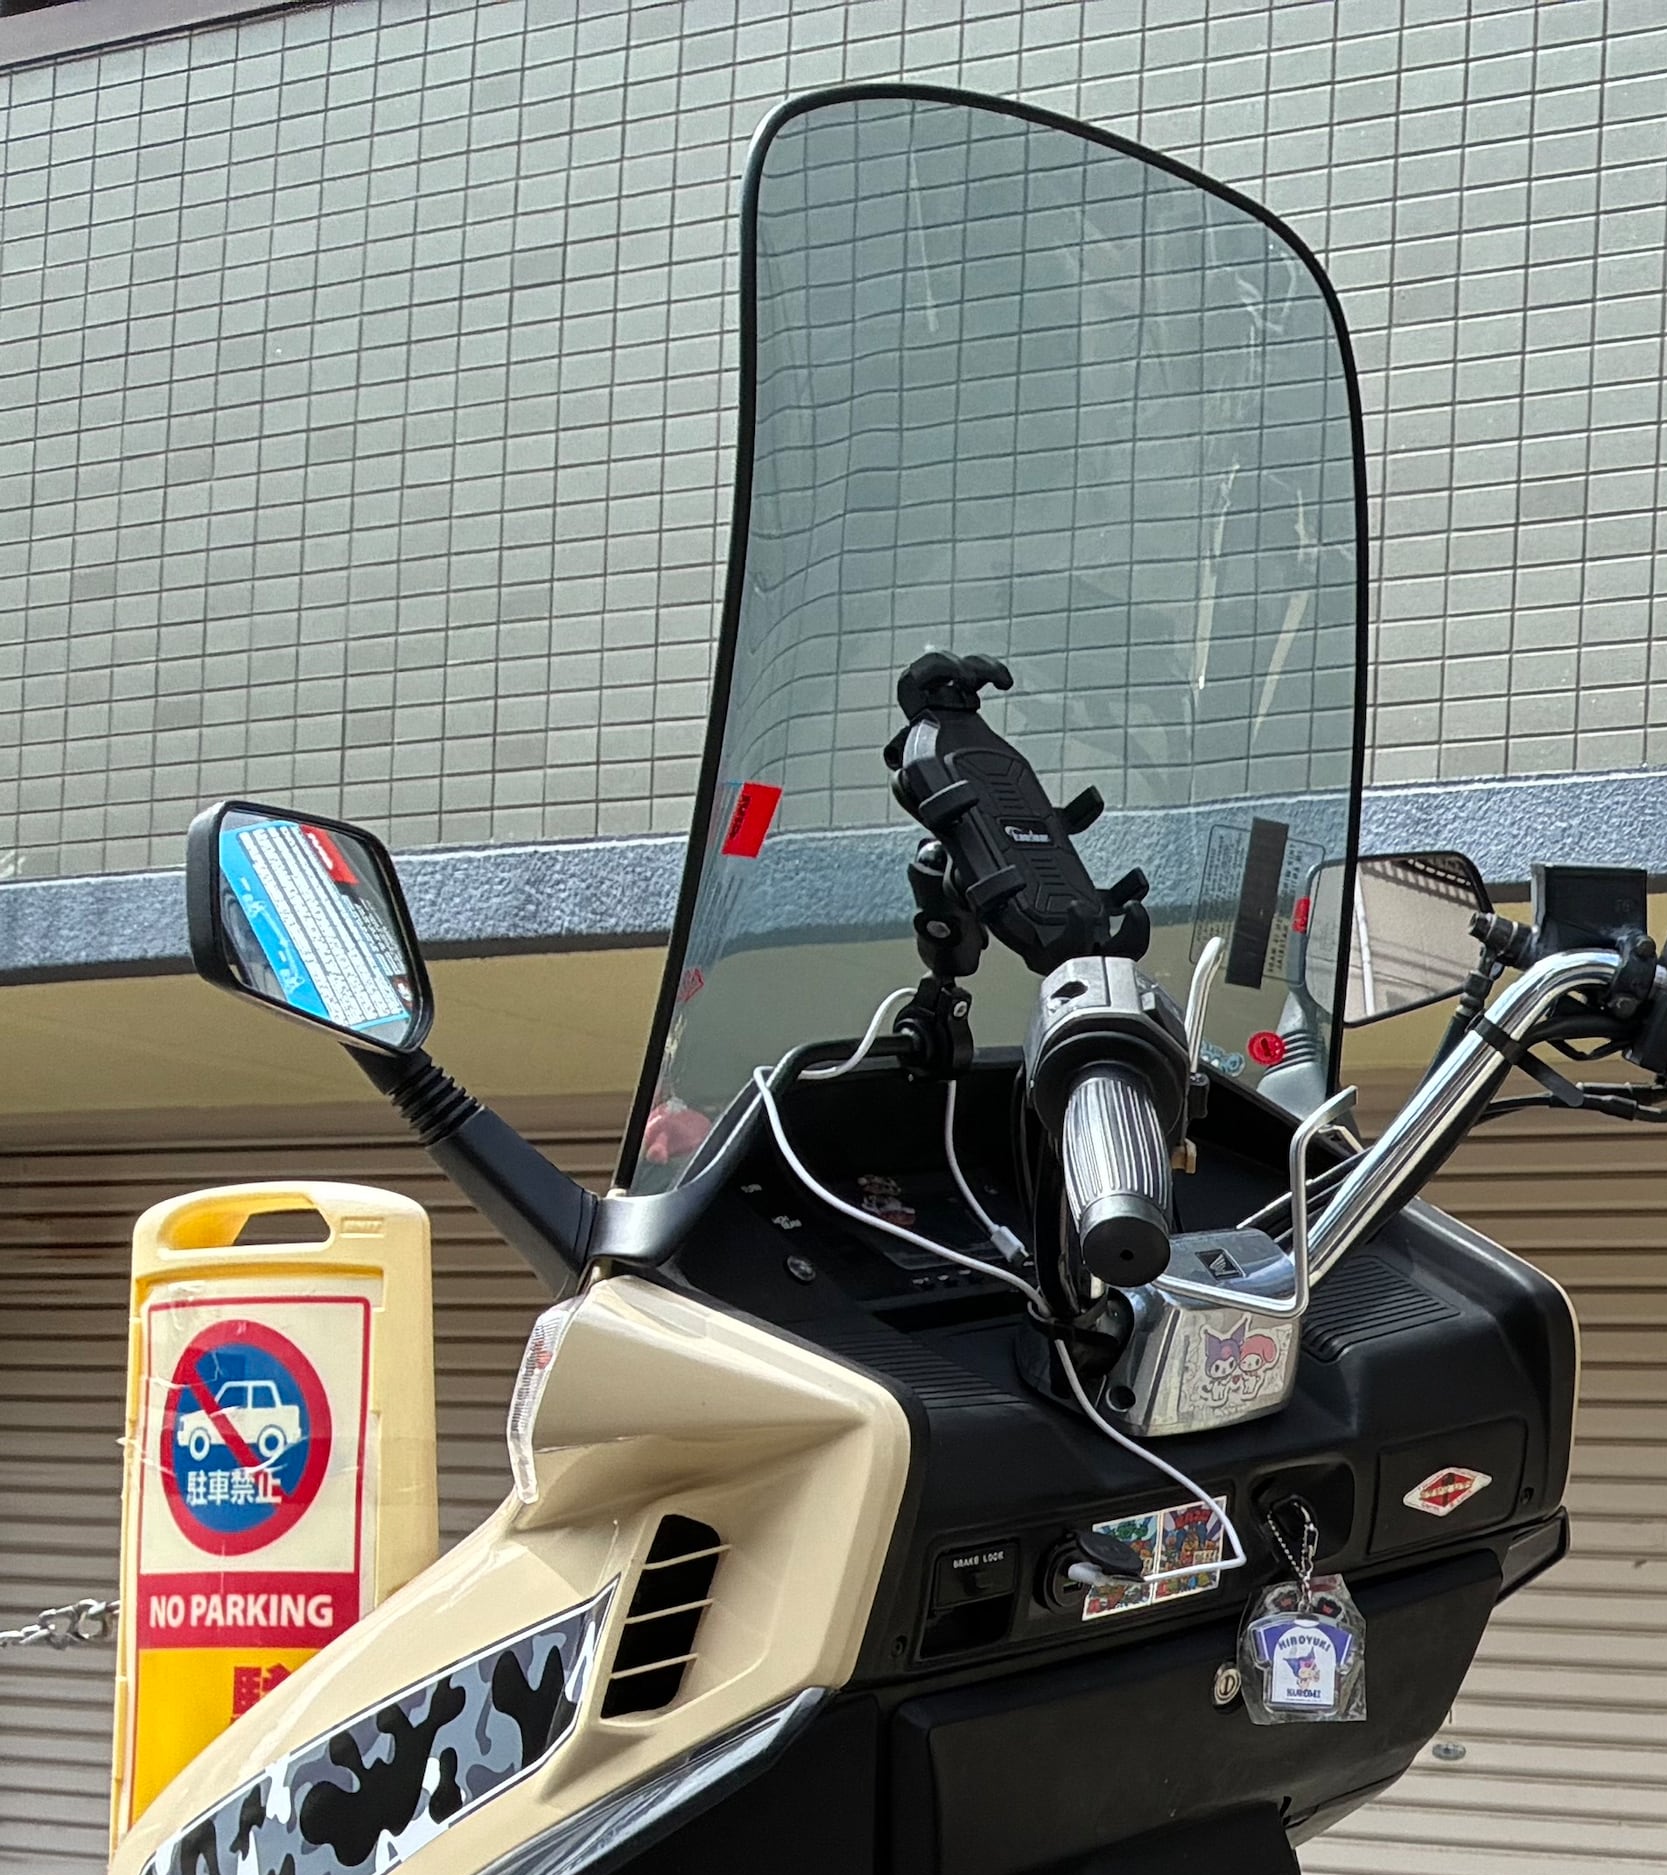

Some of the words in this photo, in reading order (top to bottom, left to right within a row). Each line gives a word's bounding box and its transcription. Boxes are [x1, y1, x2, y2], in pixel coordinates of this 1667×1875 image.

[187, 1468, 282, 1505] 駐車禁止
[150, 1595, 185, 1628] NO
[190, 1593, 334, 1628] PARKING
[1278, 1634, 1332, 1653] HIROYUKI
